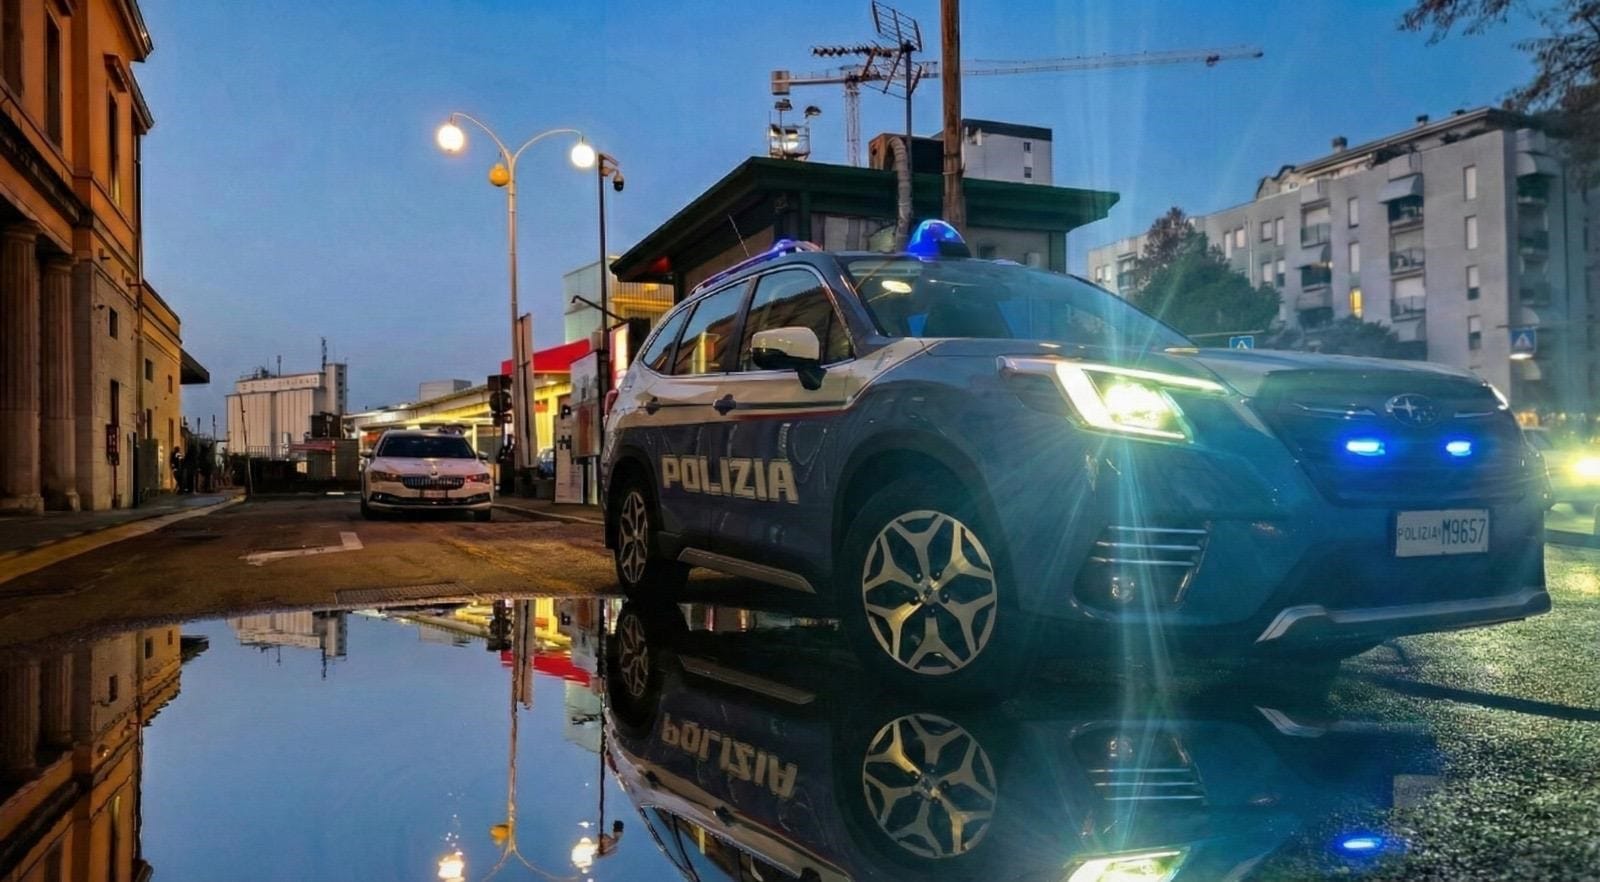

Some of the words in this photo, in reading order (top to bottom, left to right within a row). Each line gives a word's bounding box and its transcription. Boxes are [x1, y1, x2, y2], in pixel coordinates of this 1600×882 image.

[661, 455, 799, 504] POLIZIA
[1398, 526, 1437, 541] POLIZIA
[1442, 518, 1487, 545] M9657
